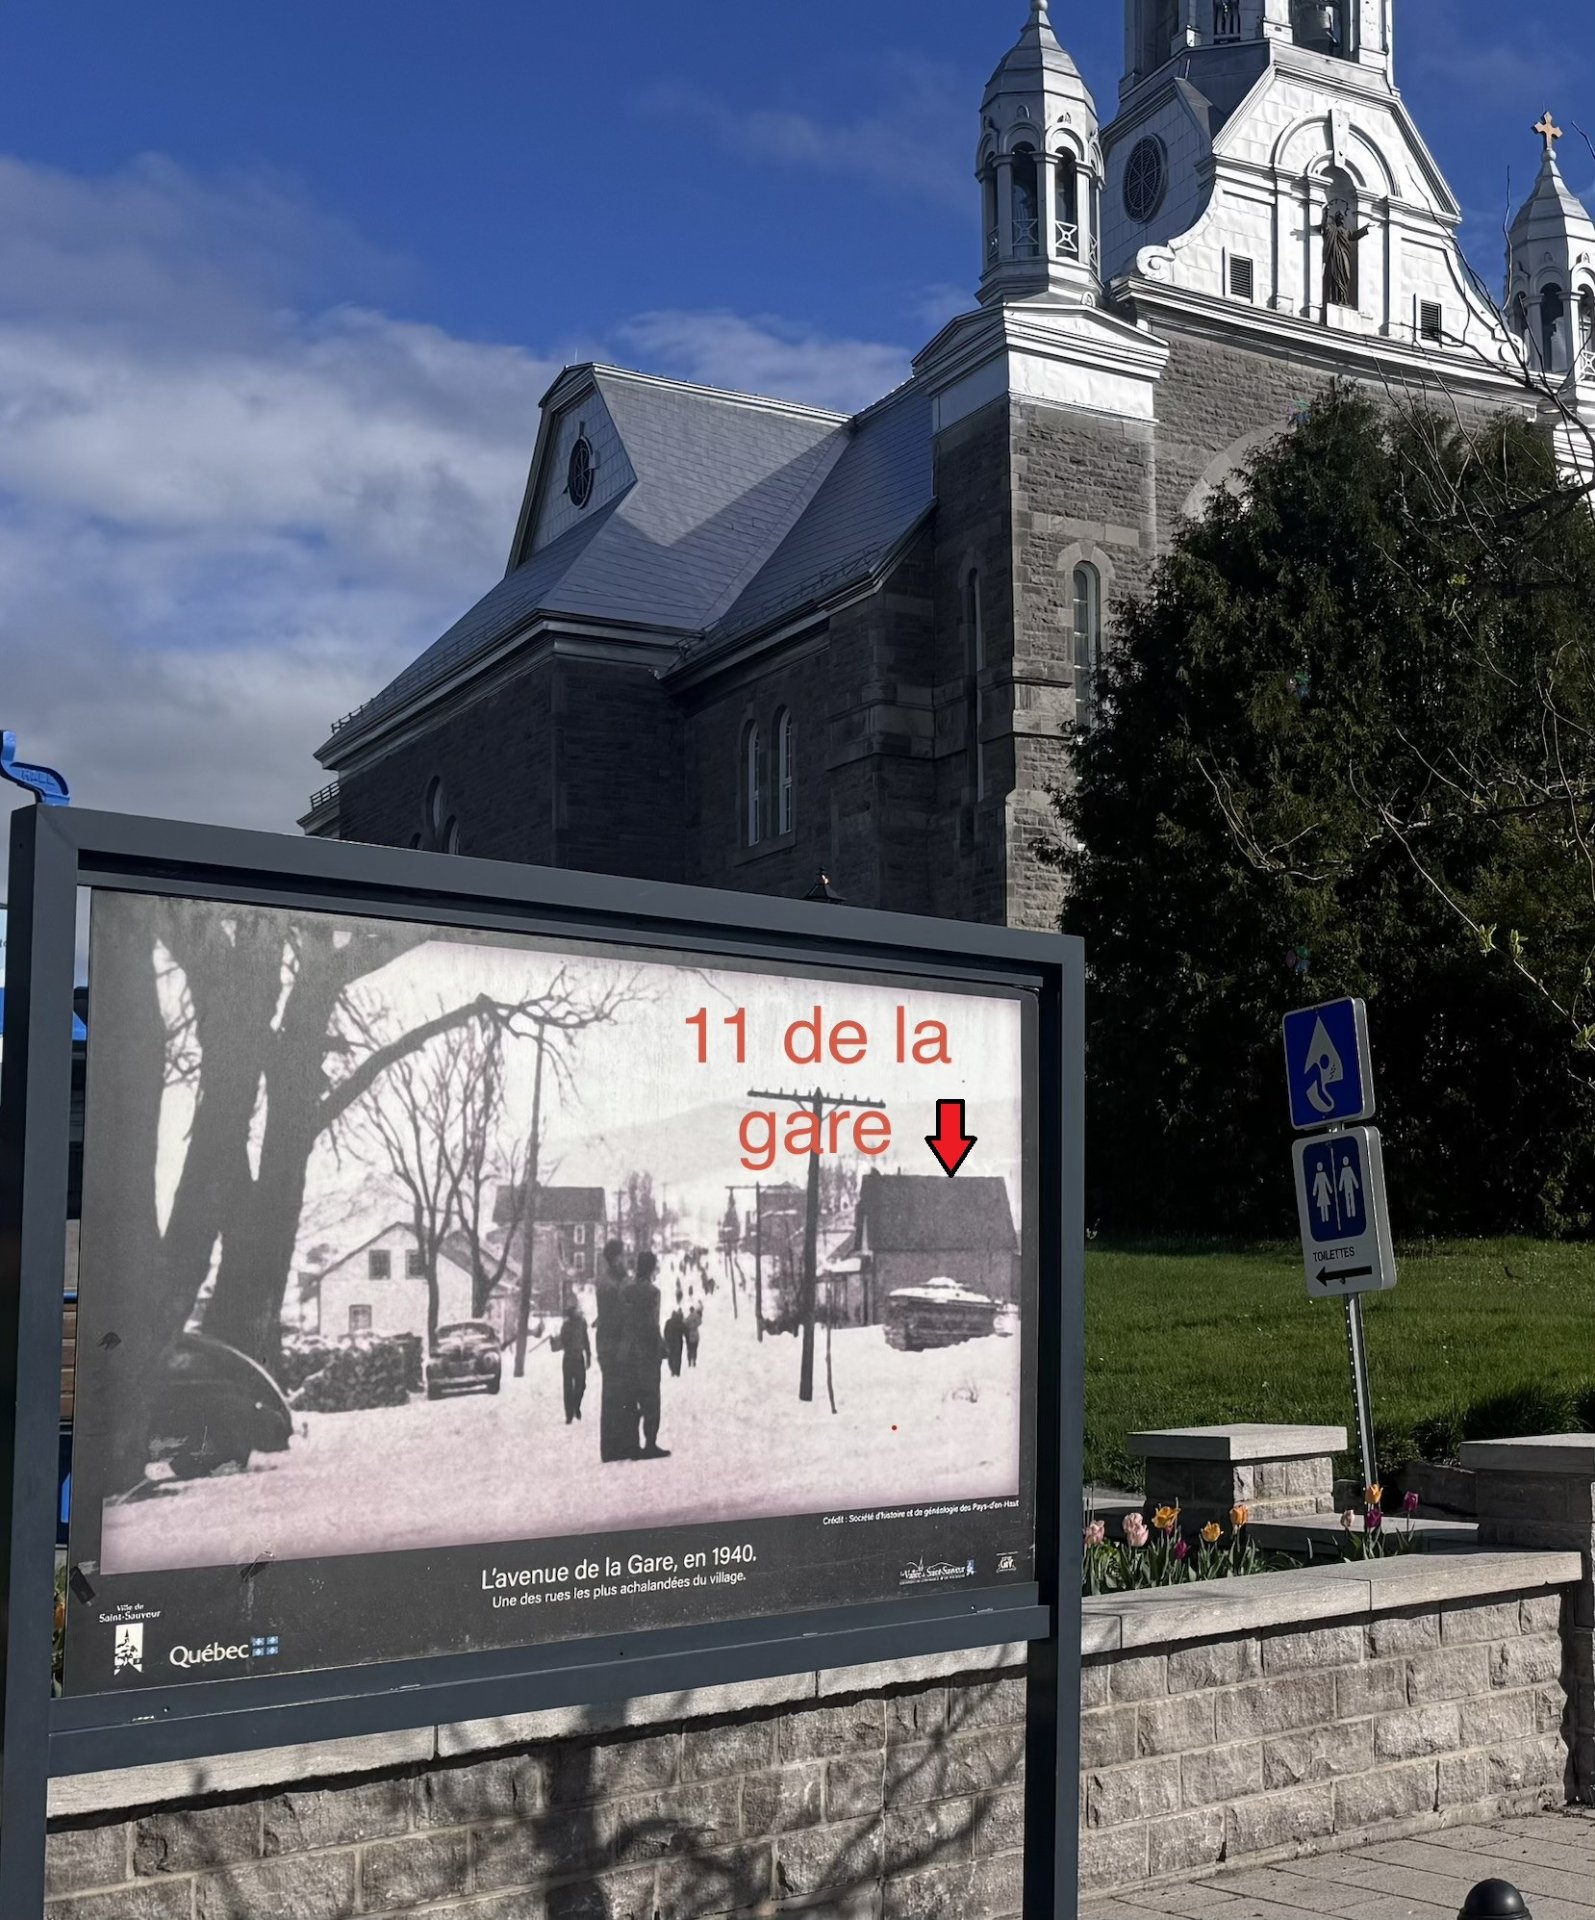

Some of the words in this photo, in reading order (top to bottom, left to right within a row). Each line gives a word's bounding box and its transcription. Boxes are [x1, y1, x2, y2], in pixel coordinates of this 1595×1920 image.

[1312, 1246, 1355, 1262] TOILETTES
[823, 1515, 844, 1525] Crédit
[849, 1512, 874, 1523] Société
[875, 1510, 905, 1520] d'histoire
[906, 1509, 913, 1517] et
[923, 1505, 958, 1517] généalogie
[960, 1504, 972, 1512] des
[481, 1566, 569, 1590] L'avenue
[574, 1558, 599, 1580] de
[606, 1557, 621, 1577] la
[627, 1553, 678, 1574] Gare,
[683, 1552, 706, 1569] en
[712, 1544, 757, 1566] 1940.
[492, 1595, 517, 1608] Une
[520, 1591, 542, 1605] des
[545, 1590, 571, 1603] rues
[574, 1587, 590, 1599] les
[593, 1584, 617, 1600] plus
[620, 1574, 690, 1595] achalandées
[693, 1572, 707, 1586] du
[709, 1569, 746, 1586] village.
[169, 1642, 249, 1668] Québec
